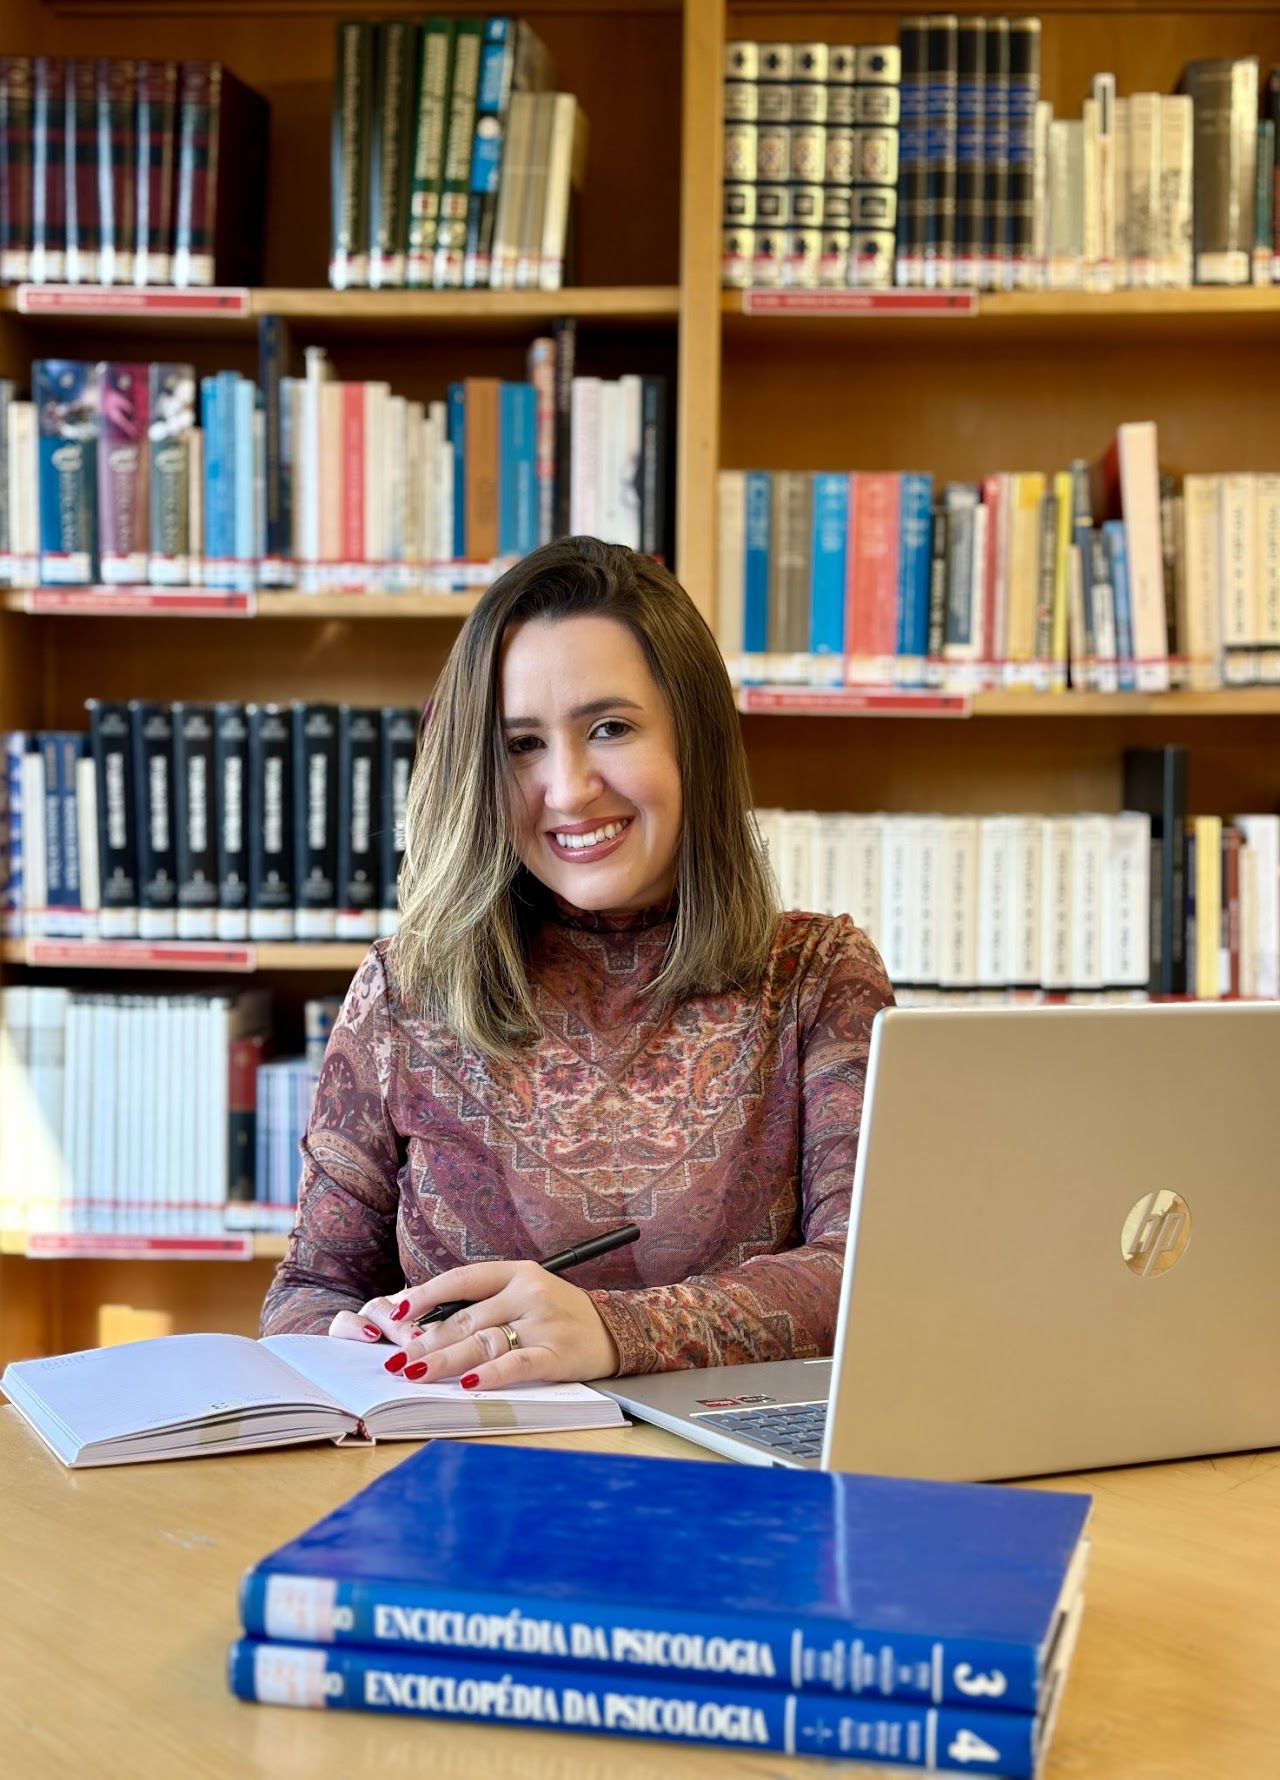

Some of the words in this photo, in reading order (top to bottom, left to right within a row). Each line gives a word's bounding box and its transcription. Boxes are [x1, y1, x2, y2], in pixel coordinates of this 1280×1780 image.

[1127, 1190, 1187, 1277] hp
[373, 1603, 567, 1653] ENCICLOPÉDIA
[570, 1624, 612, 1661] DA
[612, 1628, 776, 1678] PSICOLOGIA
[363, 1670, 559, 1723] ENCICLOPÉDIA
[562, 1690, 603, 1728] DA
[603, 1693, 769, 1744] PSICOLOGIA
[952, 1661, 1007, 1698] 3
[947, 1728, 1001, 1764] 4
